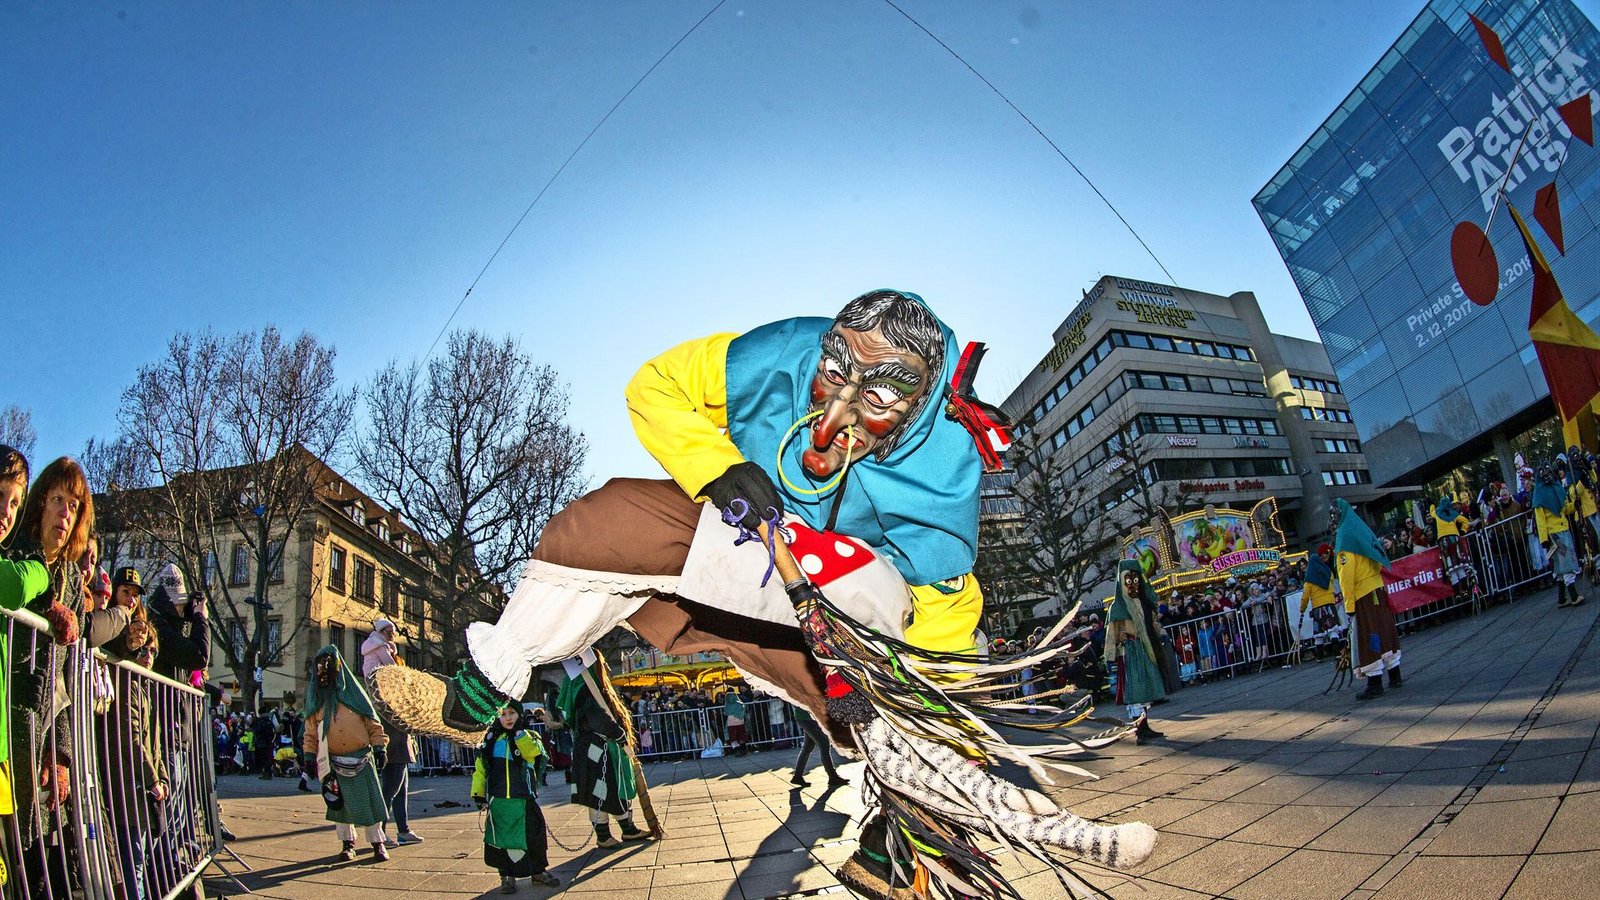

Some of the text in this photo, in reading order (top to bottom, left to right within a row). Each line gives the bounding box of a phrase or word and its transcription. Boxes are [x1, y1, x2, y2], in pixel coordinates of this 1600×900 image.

[1437, 34, 1589, 184] Patrick
[1117, 278, 1174, 296] buchhaus
[1116, 300, 1196, 321] STUTTGARTER
[1121, 290, 1178, 309] wittwer
[1136, 311, 1188, 329] ZEITUNG
[1406, 293, 1453, 332] Private
[1051, 331, 1087, 373] ZEITUNG
[1166, 435, 1198, 448] Wesser
[1213, 549, 1280, 573] SÜSSER HIMMEL
[1387, 579, 1411, 594] HIER
[1413, 570, 1434, 585] FÜR
